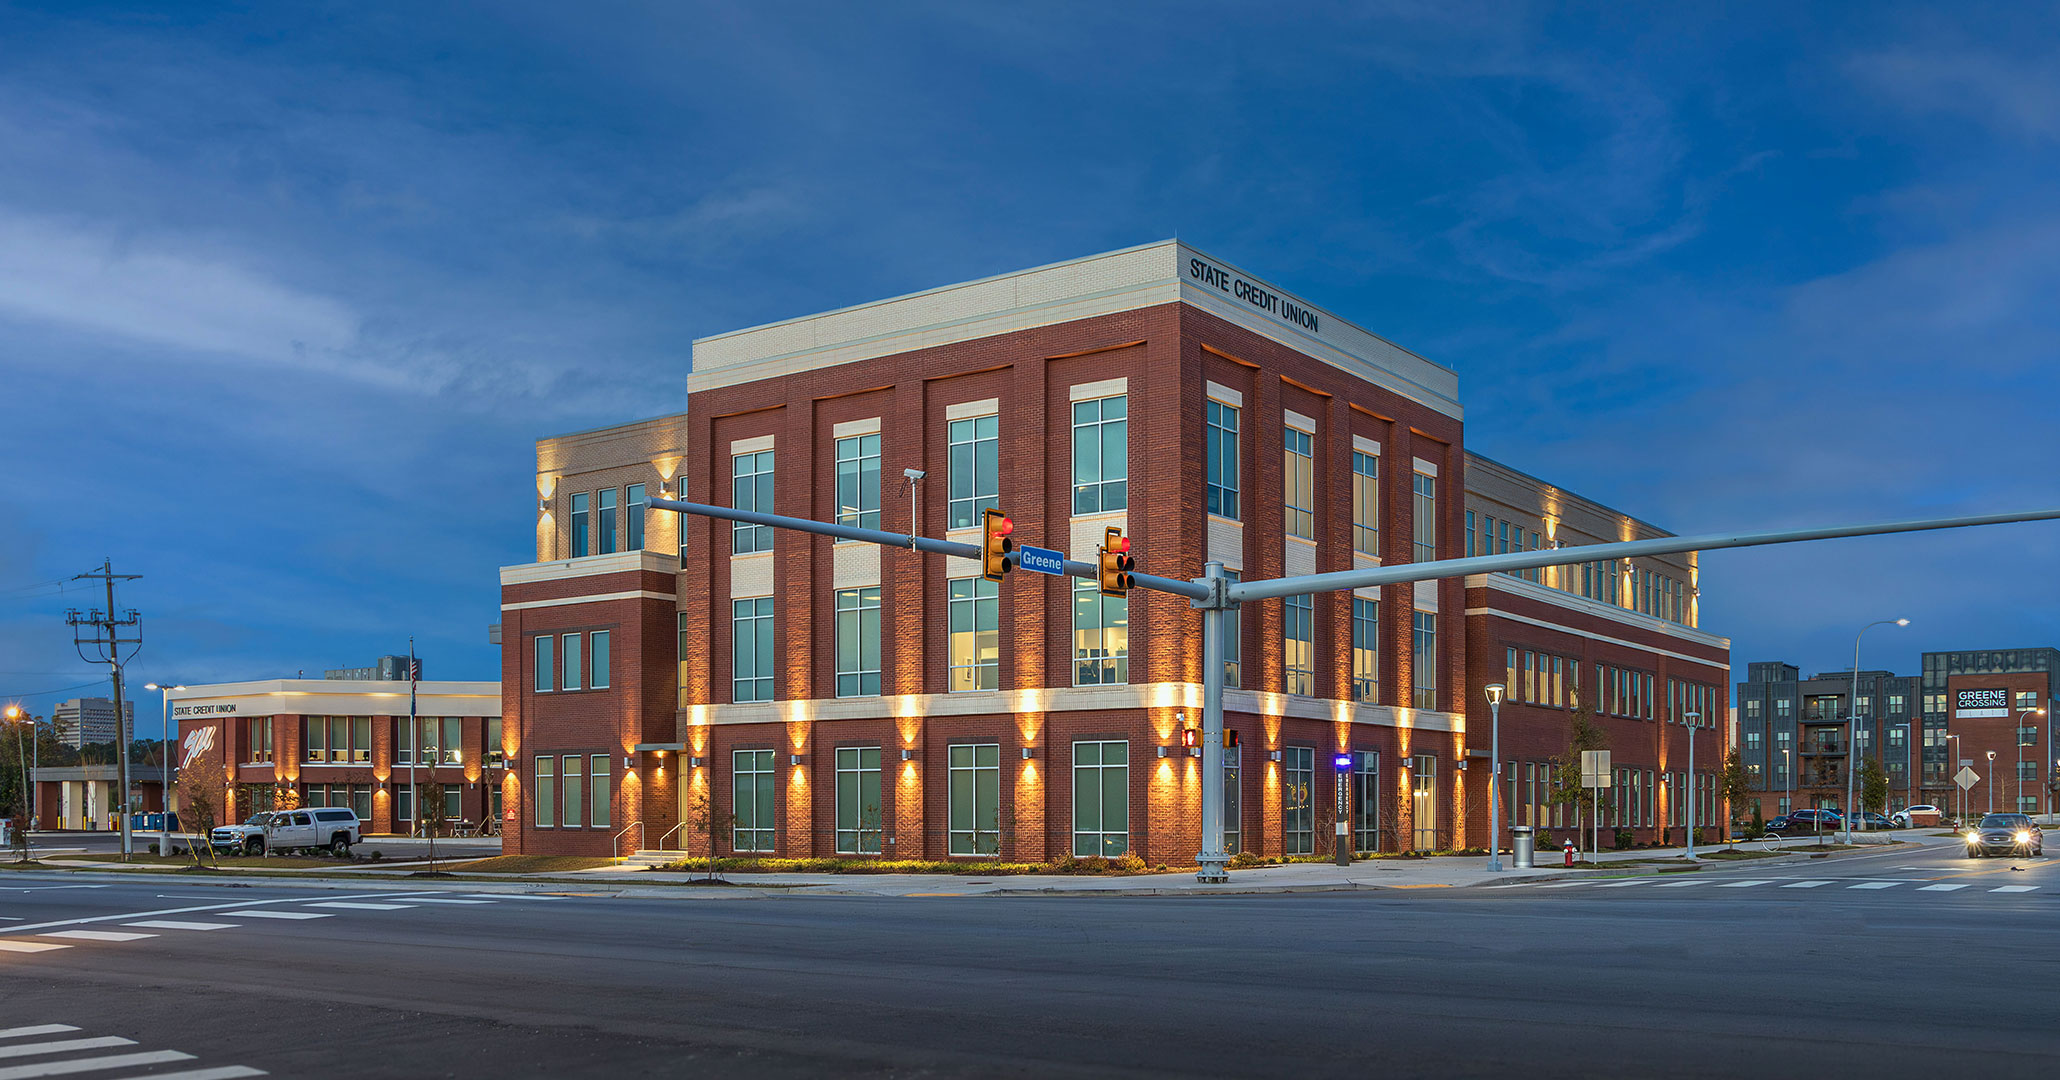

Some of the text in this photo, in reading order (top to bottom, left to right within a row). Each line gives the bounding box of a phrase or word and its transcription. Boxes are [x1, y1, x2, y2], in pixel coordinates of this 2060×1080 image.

[1190, 258, 1318, 332] STATE CREDIT UNION
[1023, 551, 1062, 570] Greene
[1958, 690, 2006, 700] GREENE
[1958, 699, 2006, 708] CROSSING
[174, 704, 237, 716] STATE CREDIT UNION
